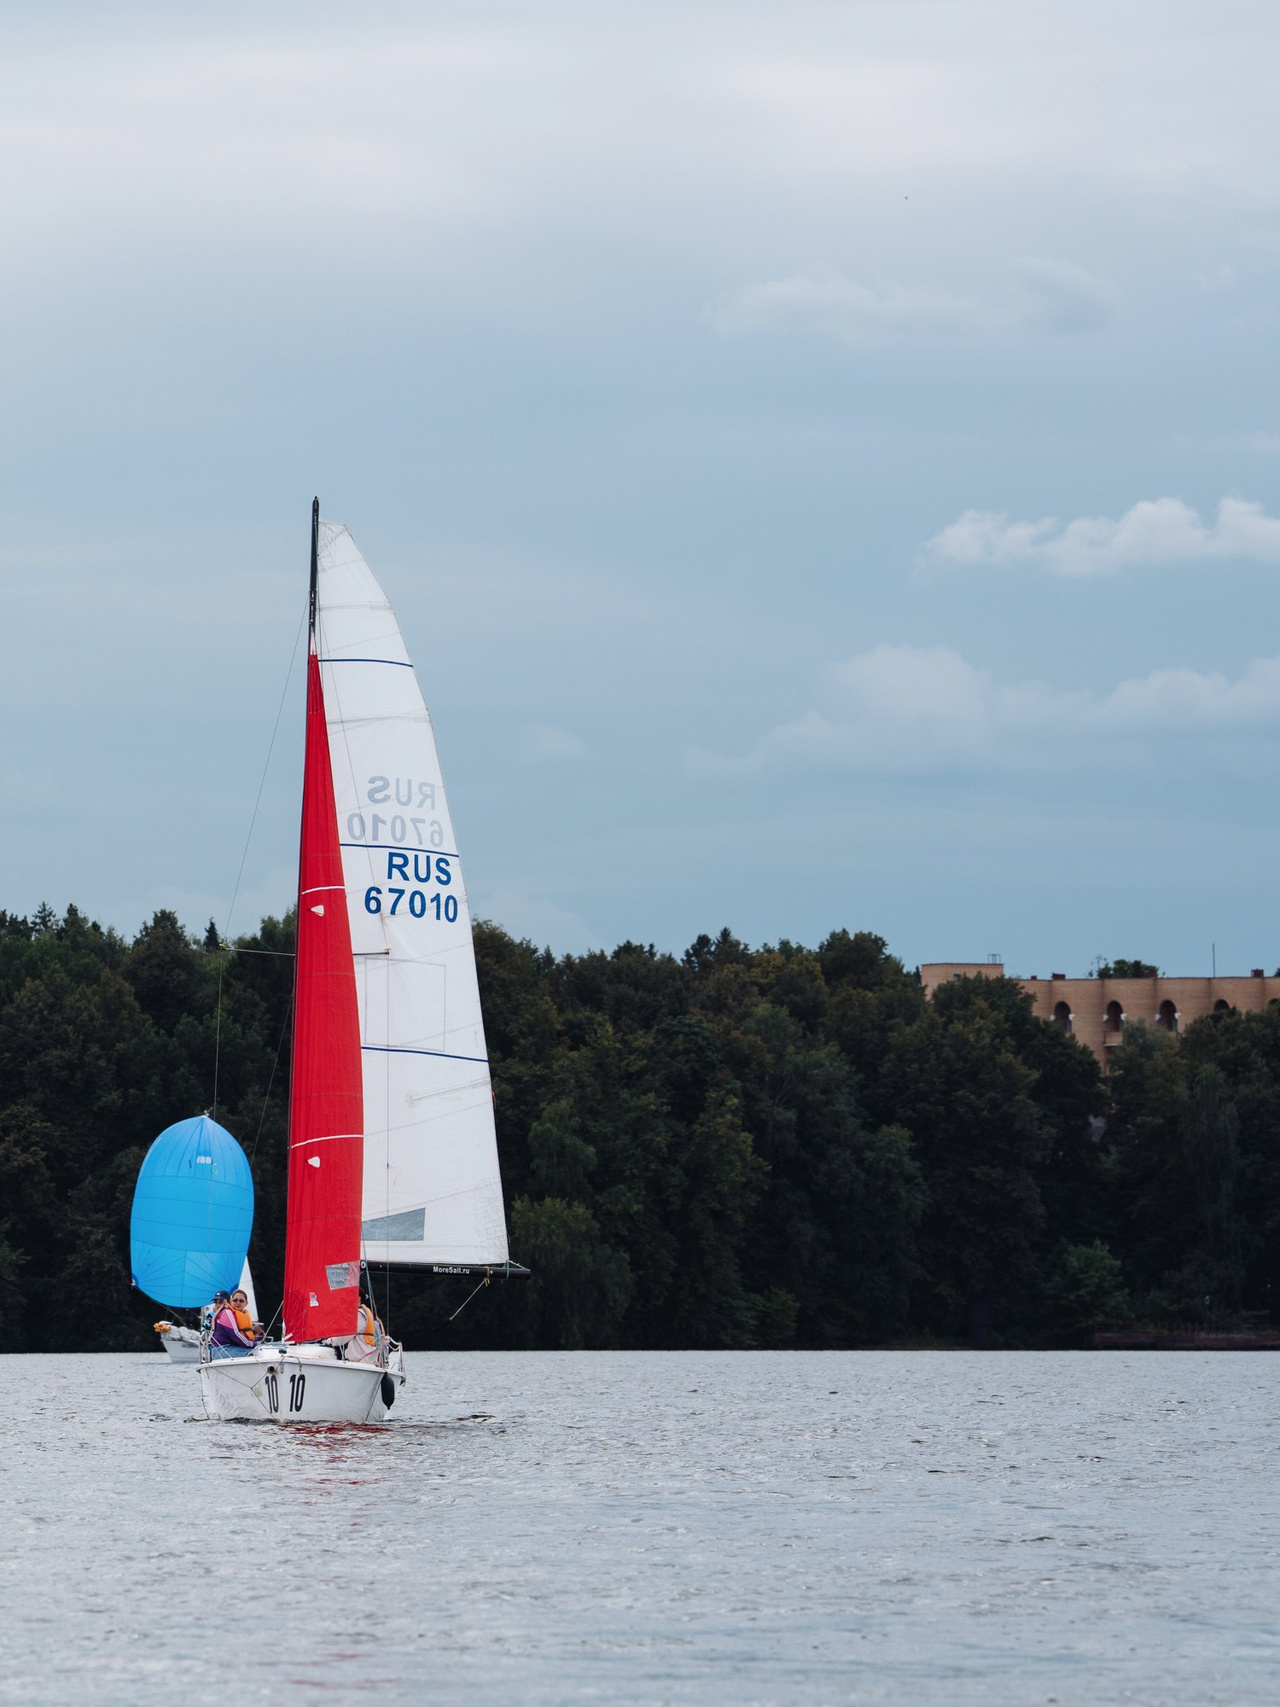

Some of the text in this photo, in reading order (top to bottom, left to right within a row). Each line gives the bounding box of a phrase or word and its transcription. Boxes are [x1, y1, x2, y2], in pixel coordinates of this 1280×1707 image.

[387, 851, 452, 886] RUS
[364, 886, 458, 923] 67010
[433, 1266, 470, 1274] MoreSail.ru
[265, 1374, 279, 1414] 10
[289, 1374, 306, 1412] 10
